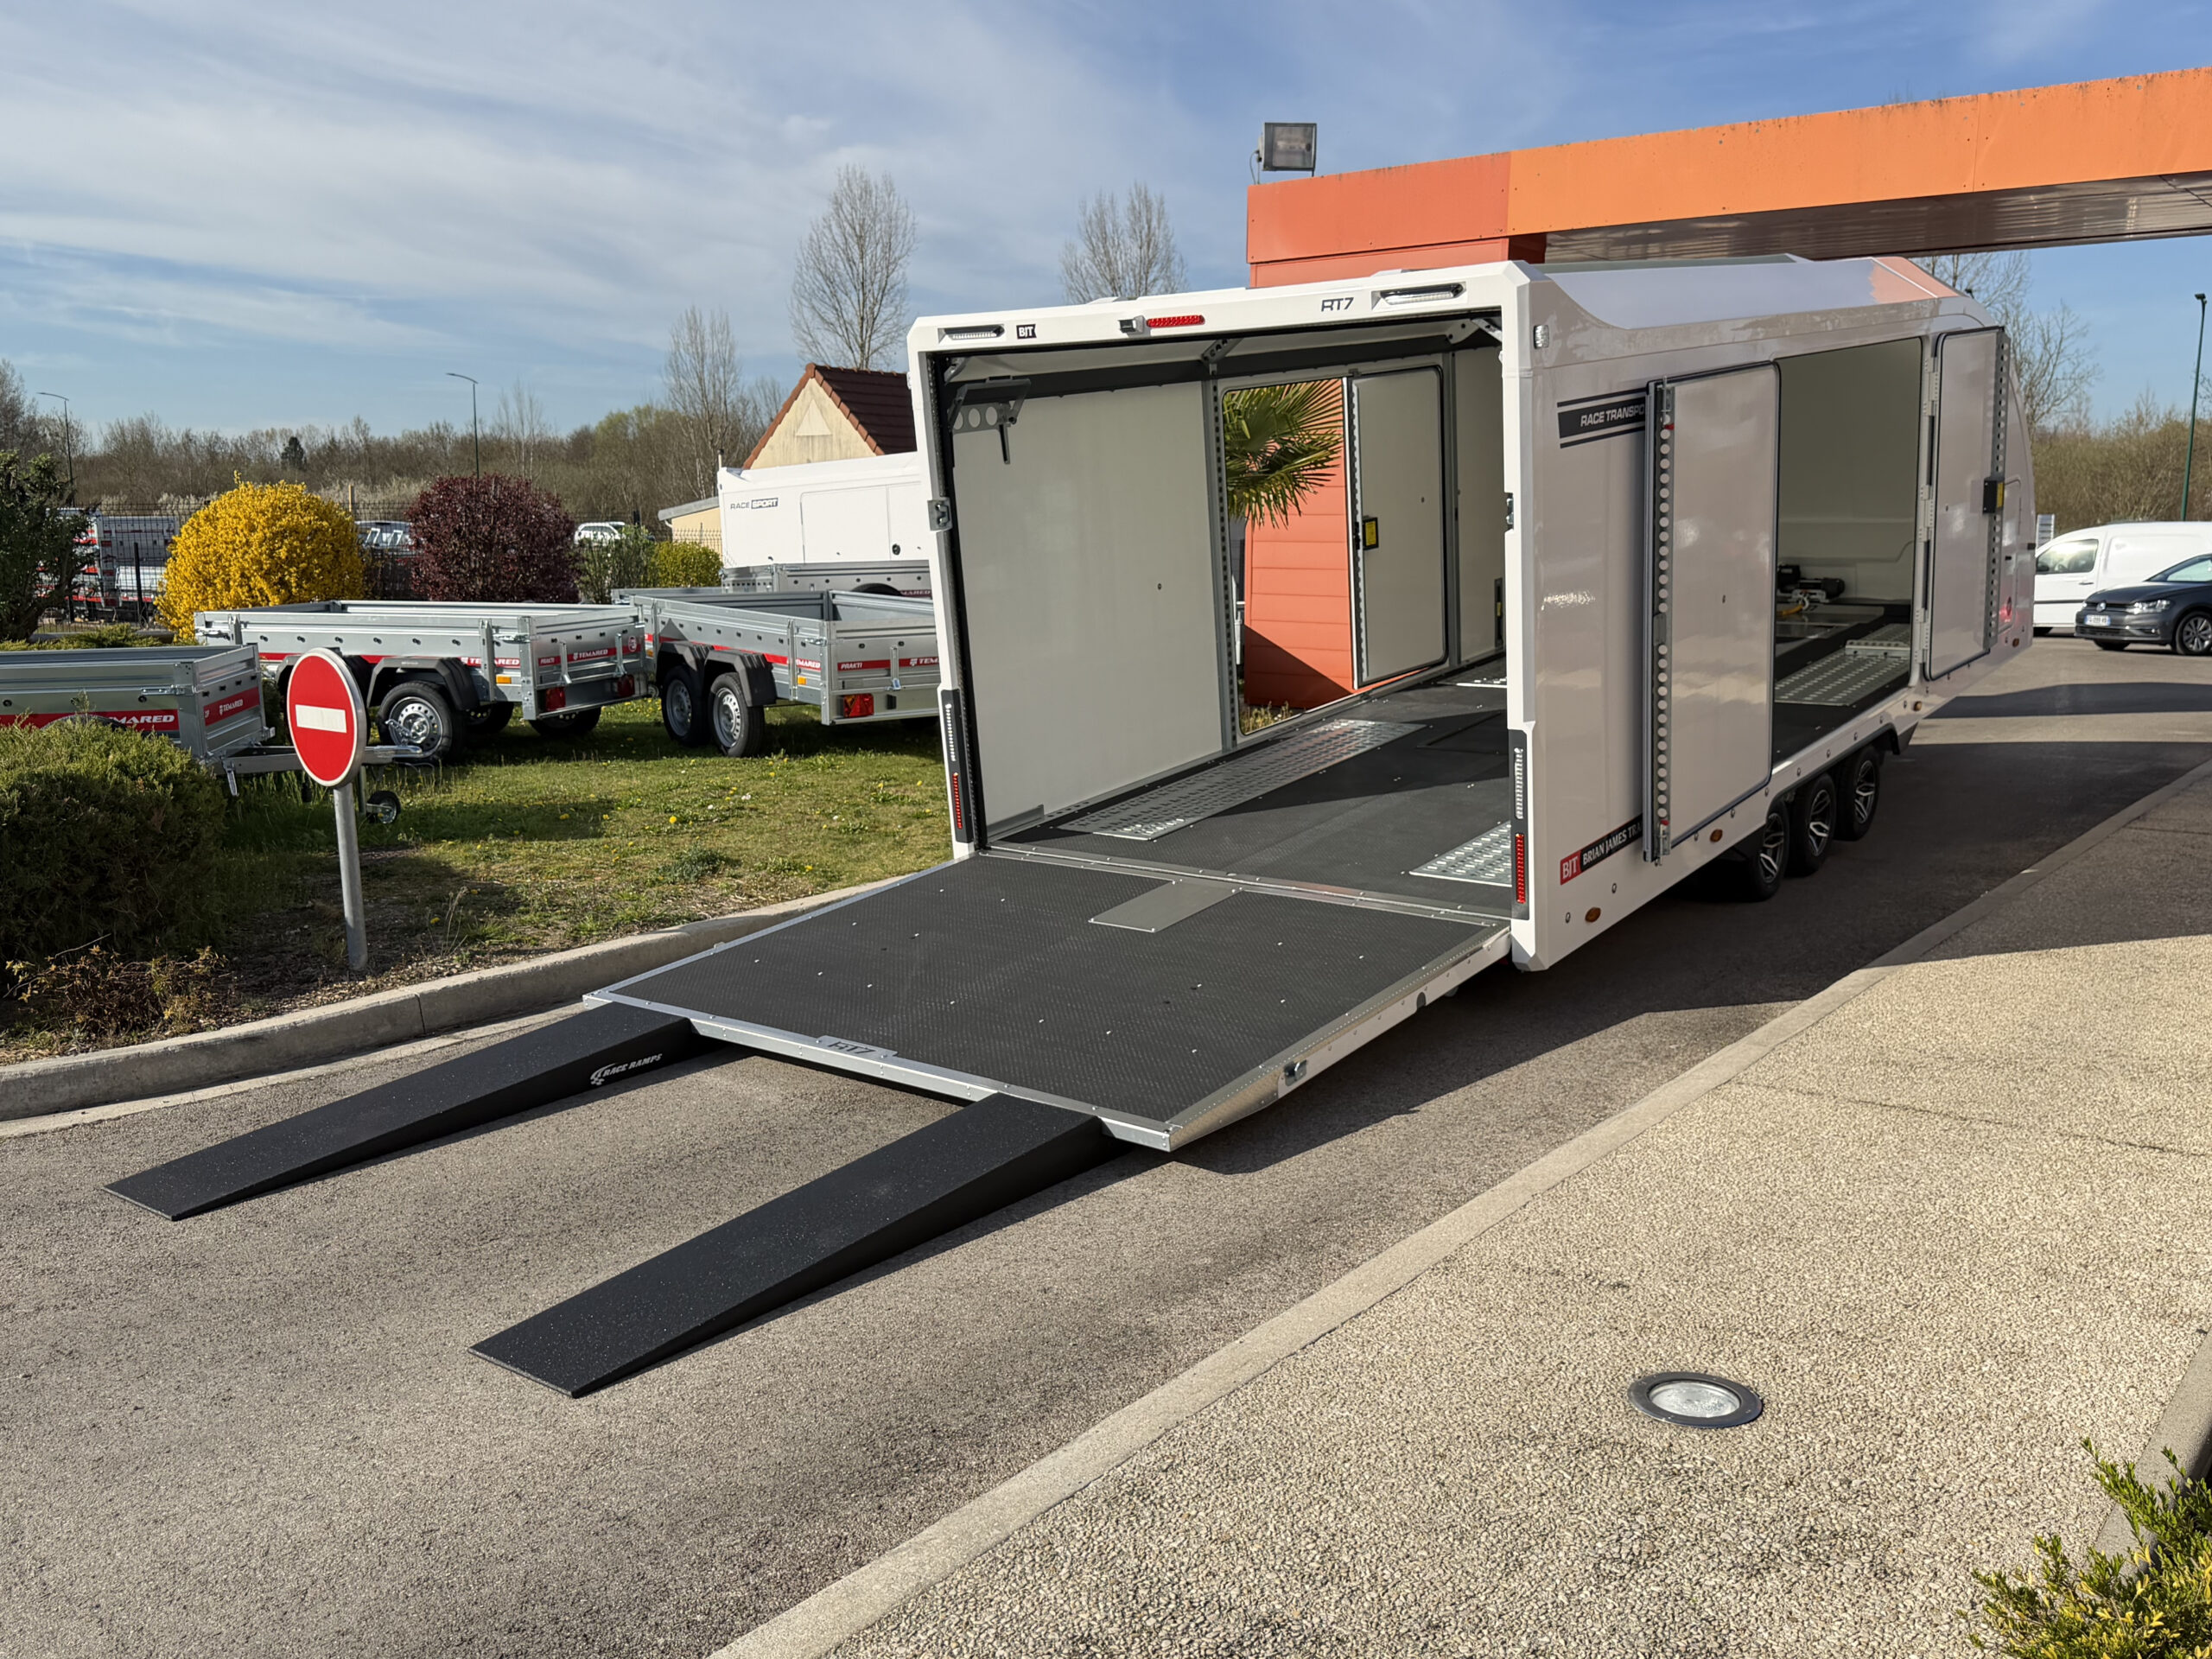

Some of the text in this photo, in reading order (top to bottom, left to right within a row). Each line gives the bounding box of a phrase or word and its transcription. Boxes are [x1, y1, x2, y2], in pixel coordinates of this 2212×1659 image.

[1321, 297, 1354, 312] RT7
[1580, 404, 1645, 427] RACE TRANSPO
[578, 649, 608, 658] TEMARED
[796, 659, 821, 668] EMARED
[109, 715, 175, 724] MARED
[1582, 843, 1605, 865] BRIAN
[1605, 830, 1627, 853] JAMES
[1628, 822, 1642, 838] TRA
[828, 1041, 876, 1053] RT7
[602, 1053, 663, 1077] RACE RAMPS
